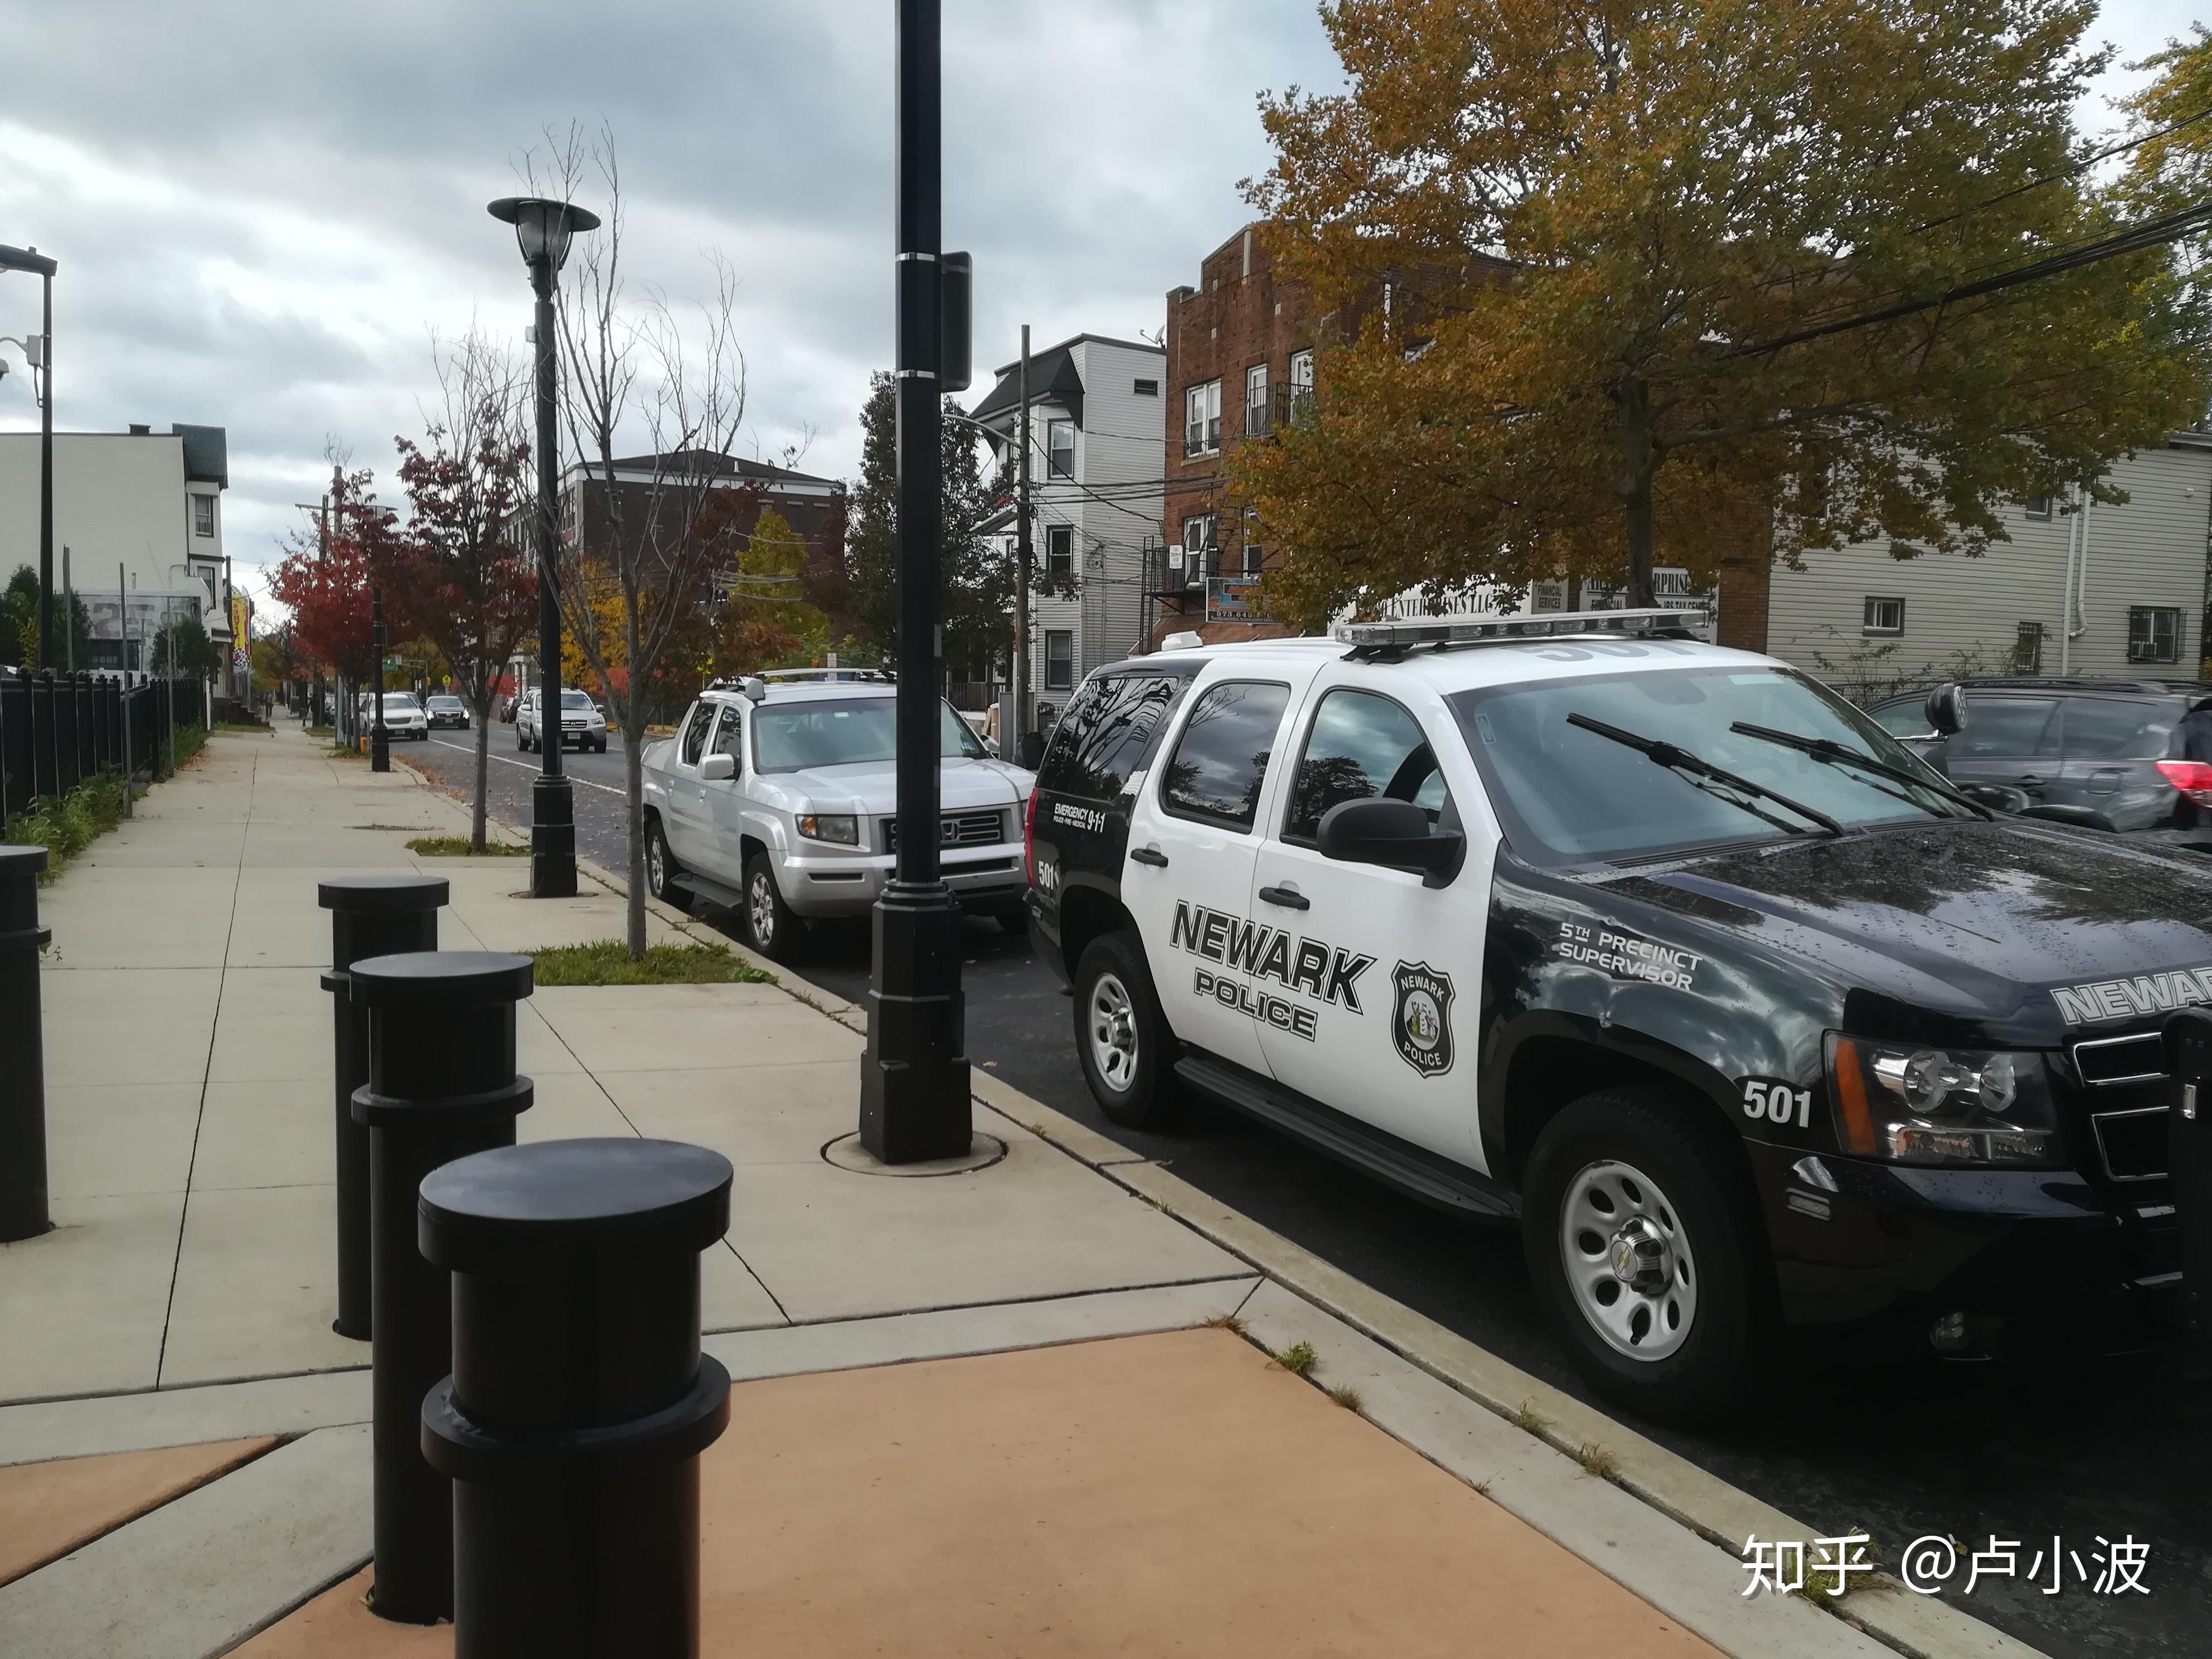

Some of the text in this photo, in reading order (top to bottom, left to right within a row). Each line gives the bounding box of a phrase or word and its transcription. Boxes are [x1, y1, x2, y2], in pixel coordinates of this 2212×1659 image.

[1538, 585, 1562, 596] FINANCIAL
[1538, 597, 1561, 609] SERVICES
[1054, 803, 1089, 821] EMERGENCY
[1039, 860, 1054, 890] 501
[1170, 899, 1378, 1016] NEWARK
[1560, 923, 1702, 971] 5TH PRECINCT
[1559, 942, 1692, 991] SUPERVISOR
[1194, 967, 1318, 1042] POLICE
[1400, 977, 1445, 1002] NEWARK
[1404, 1041, 1442, 1066] POLICE
[1744, 1081, 1811, 1128] 501
